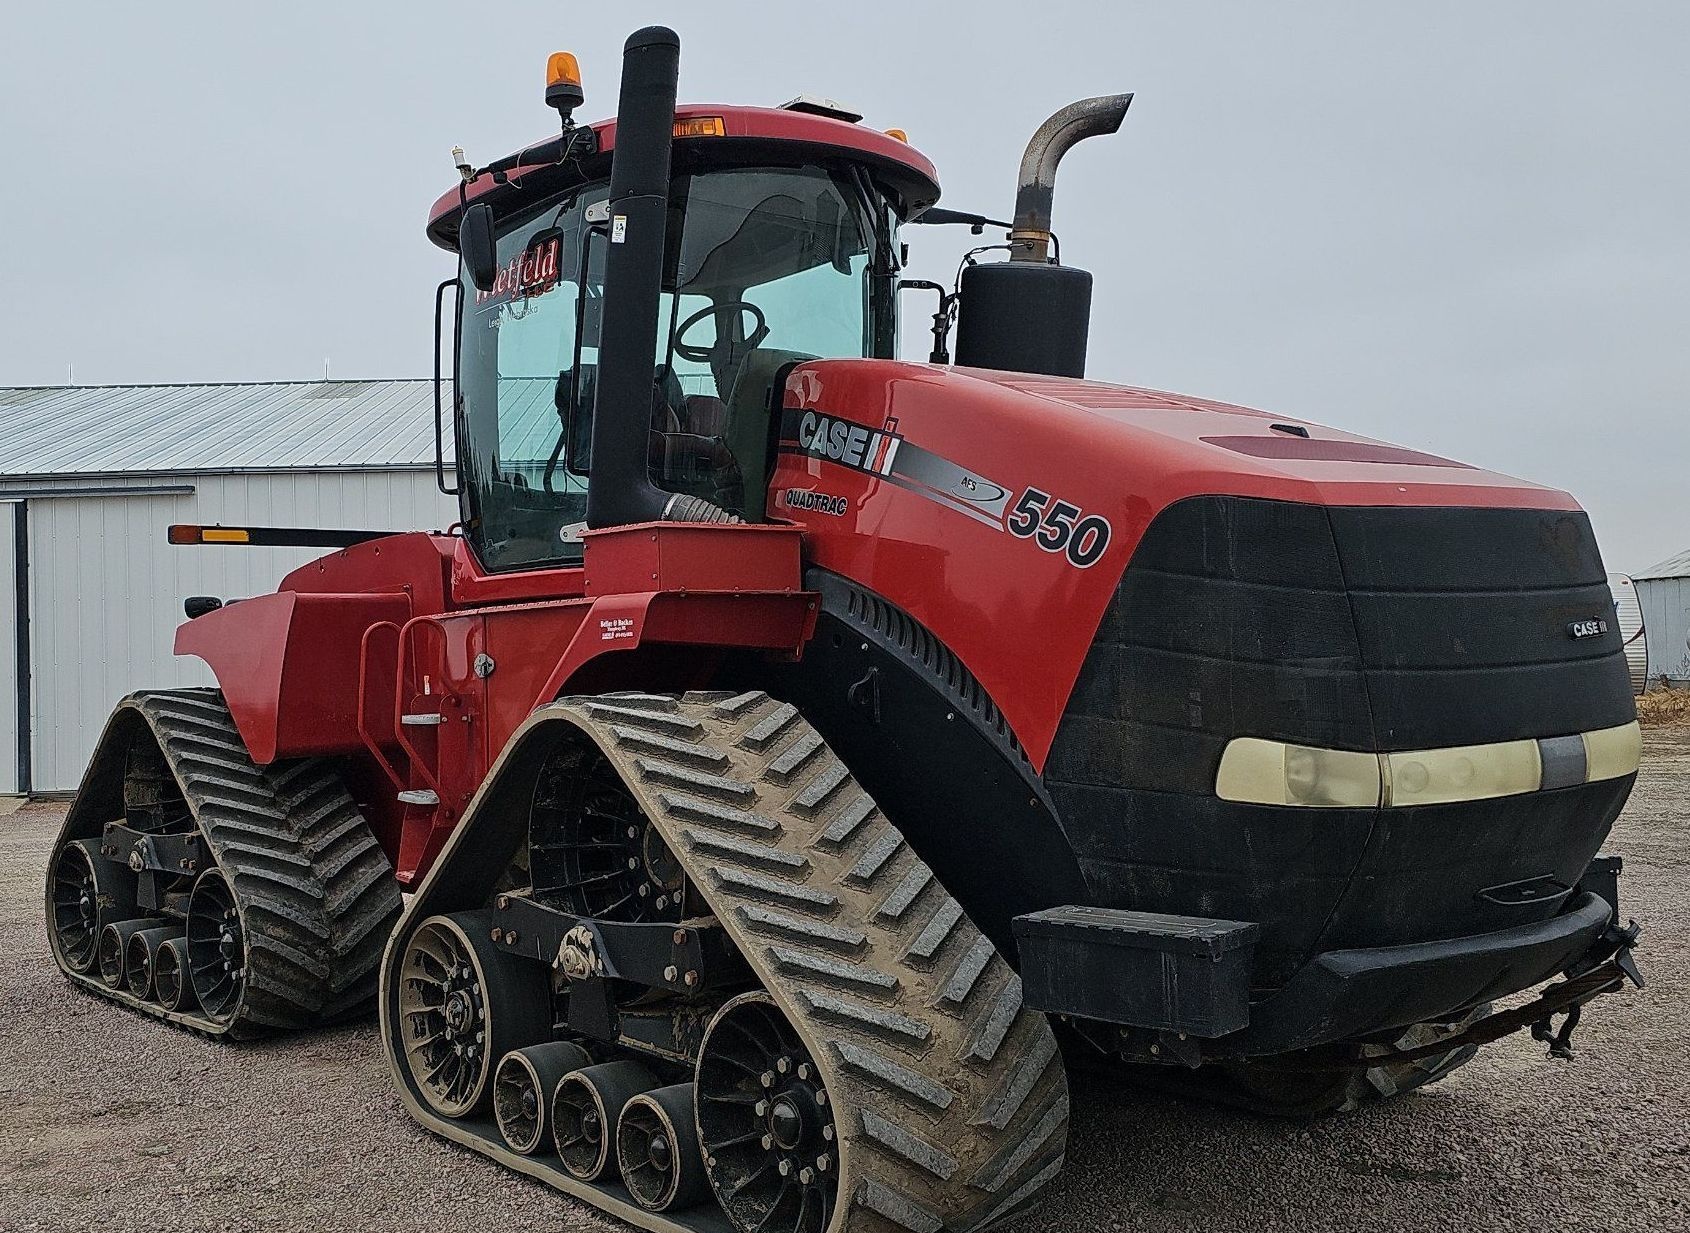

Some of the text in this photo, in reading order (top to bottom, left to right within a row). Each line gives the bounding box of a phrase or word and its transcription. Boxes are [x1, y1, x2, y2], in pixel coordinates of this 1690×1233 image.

[800, 411, 869, 467] CASE
[961, 476, 977, 492] AFS
[786, 488, 849, 517] QUADTRAC
[1007, 486, 1113, 569] 550
[1573, 621, 1599, 637] CASE
